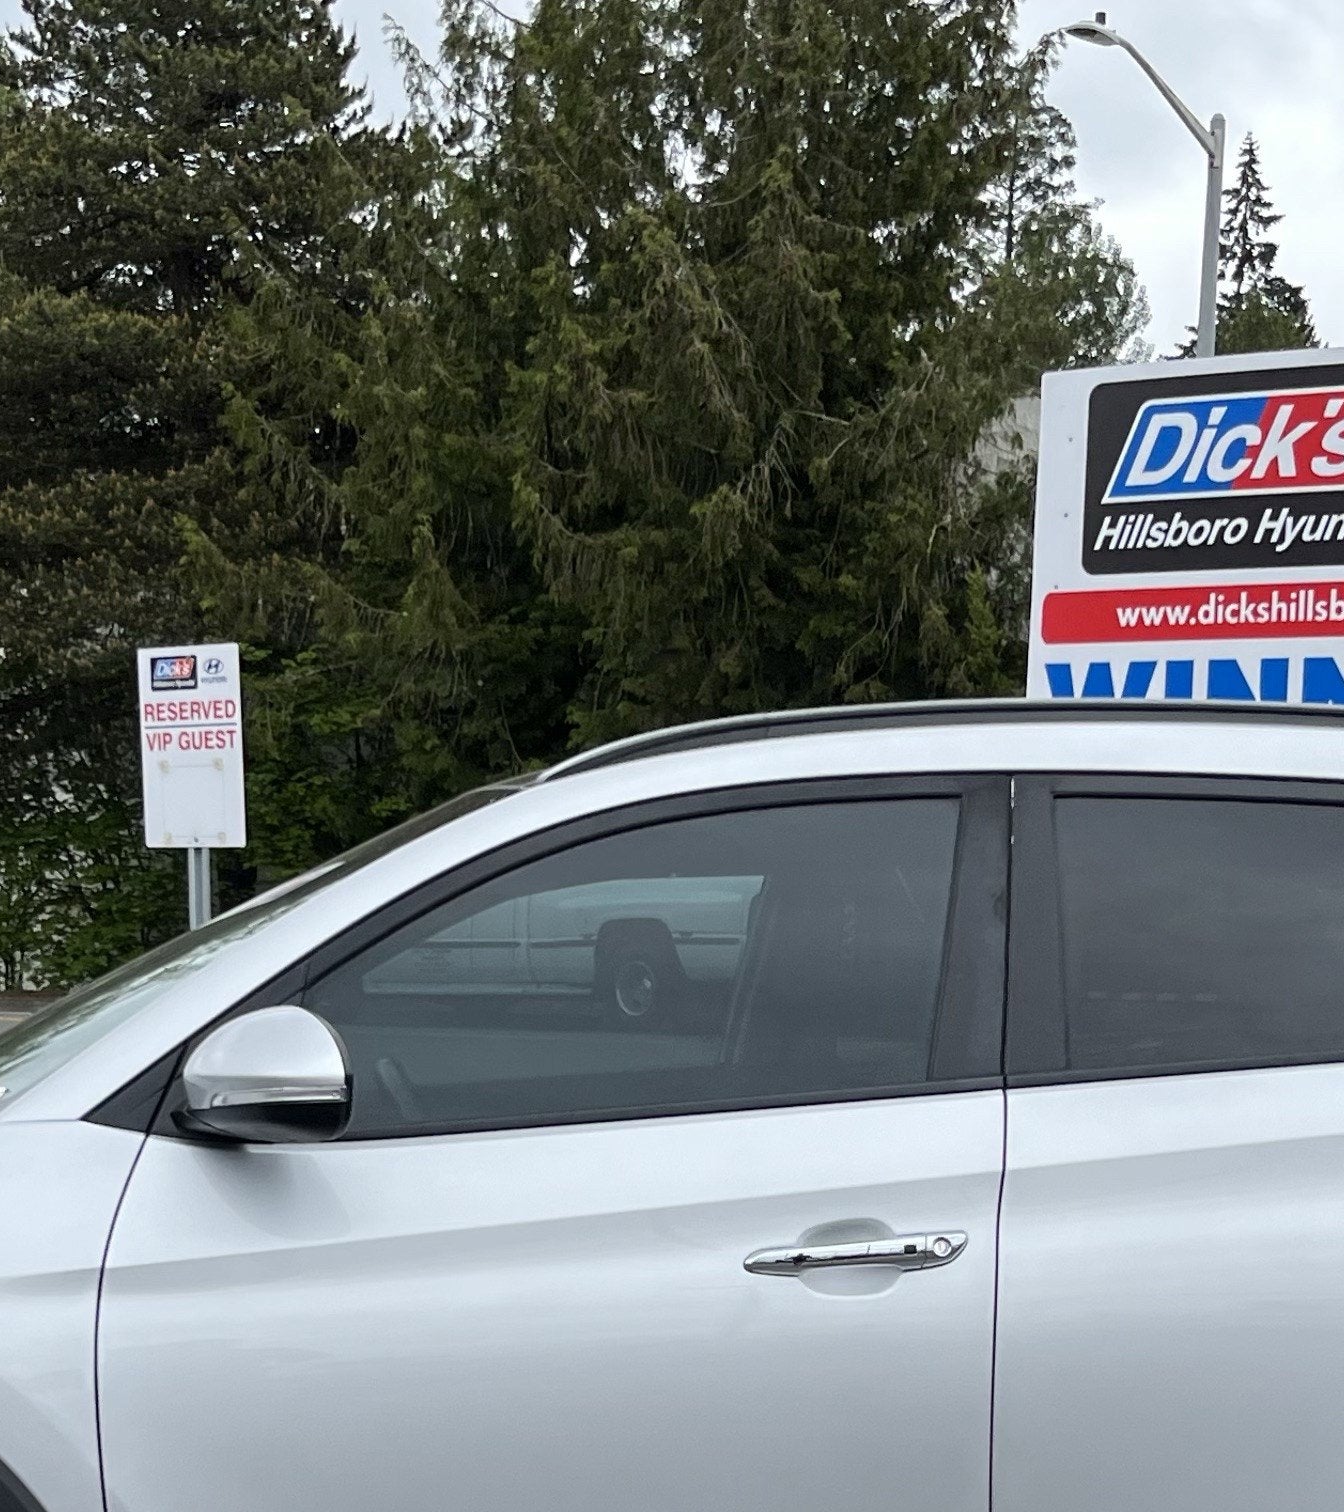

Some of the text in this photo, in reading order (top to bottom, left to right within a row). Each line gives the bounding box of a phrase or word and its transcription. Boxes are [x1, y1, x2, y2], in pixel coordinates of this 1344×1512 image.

[1093, 511, 1249, 551] Hillsboro
[144, 699, 236, 722] RESERVED
[146, 730, 237, 751] VIP GUEST
